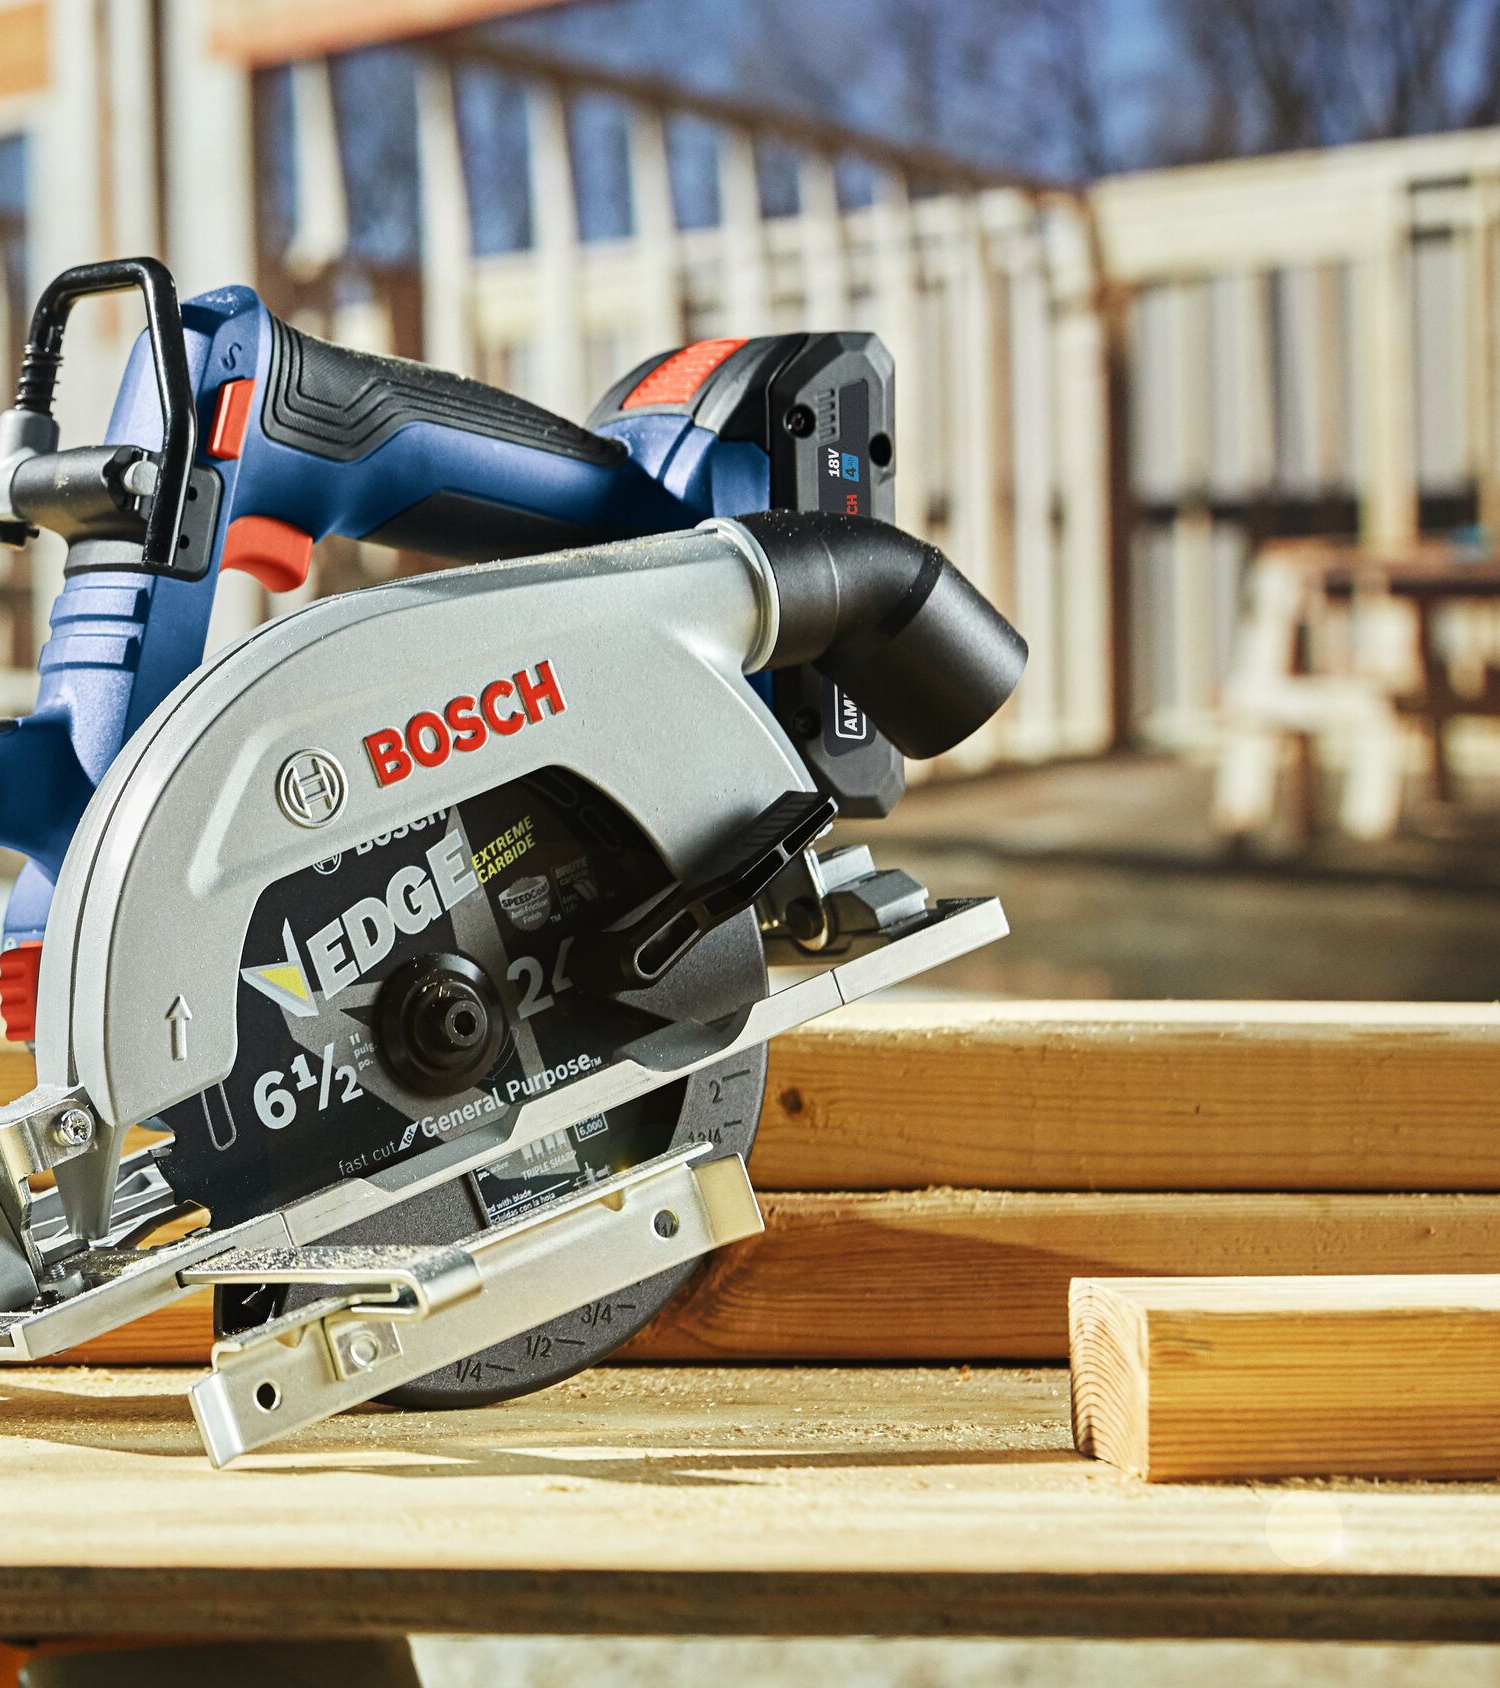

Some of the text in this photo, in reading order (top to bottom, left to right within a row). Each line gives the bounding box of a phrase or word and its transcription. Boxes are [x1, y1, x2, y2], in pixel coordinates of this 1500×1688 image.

[828, 448, 840, 478] 18V
[363, 658, 567, 788] BOSCH
[843, 692, 858, 732] AM
[471, 815, 534, 870] EXTREME
[477, 833, 536, 884] CARBIDE
[305, 828, 479, 1001] EDGE
[709, 1080, 723, 1105] 2
[338, 1153, 369, 1176] fast
[372, 1140, 397, 1162] cut
[402, 1128, 414, 1145] for
[420, 1087, 505, 1138] General
[505, 1052, 592, 1102] Purpose
[579, 1118, 603, 1136] 6,000
[521, 1150, 577, 1181] TRIPLE SHARP
[496, 1197, 512, 1209] with
[512, 1188, 532, 1203] blade
[581, 1301, 612, 1328] 3/4
[526, 1334, 552, 1361] 1/2
[456, 1358, 482, 1384] 1/4
